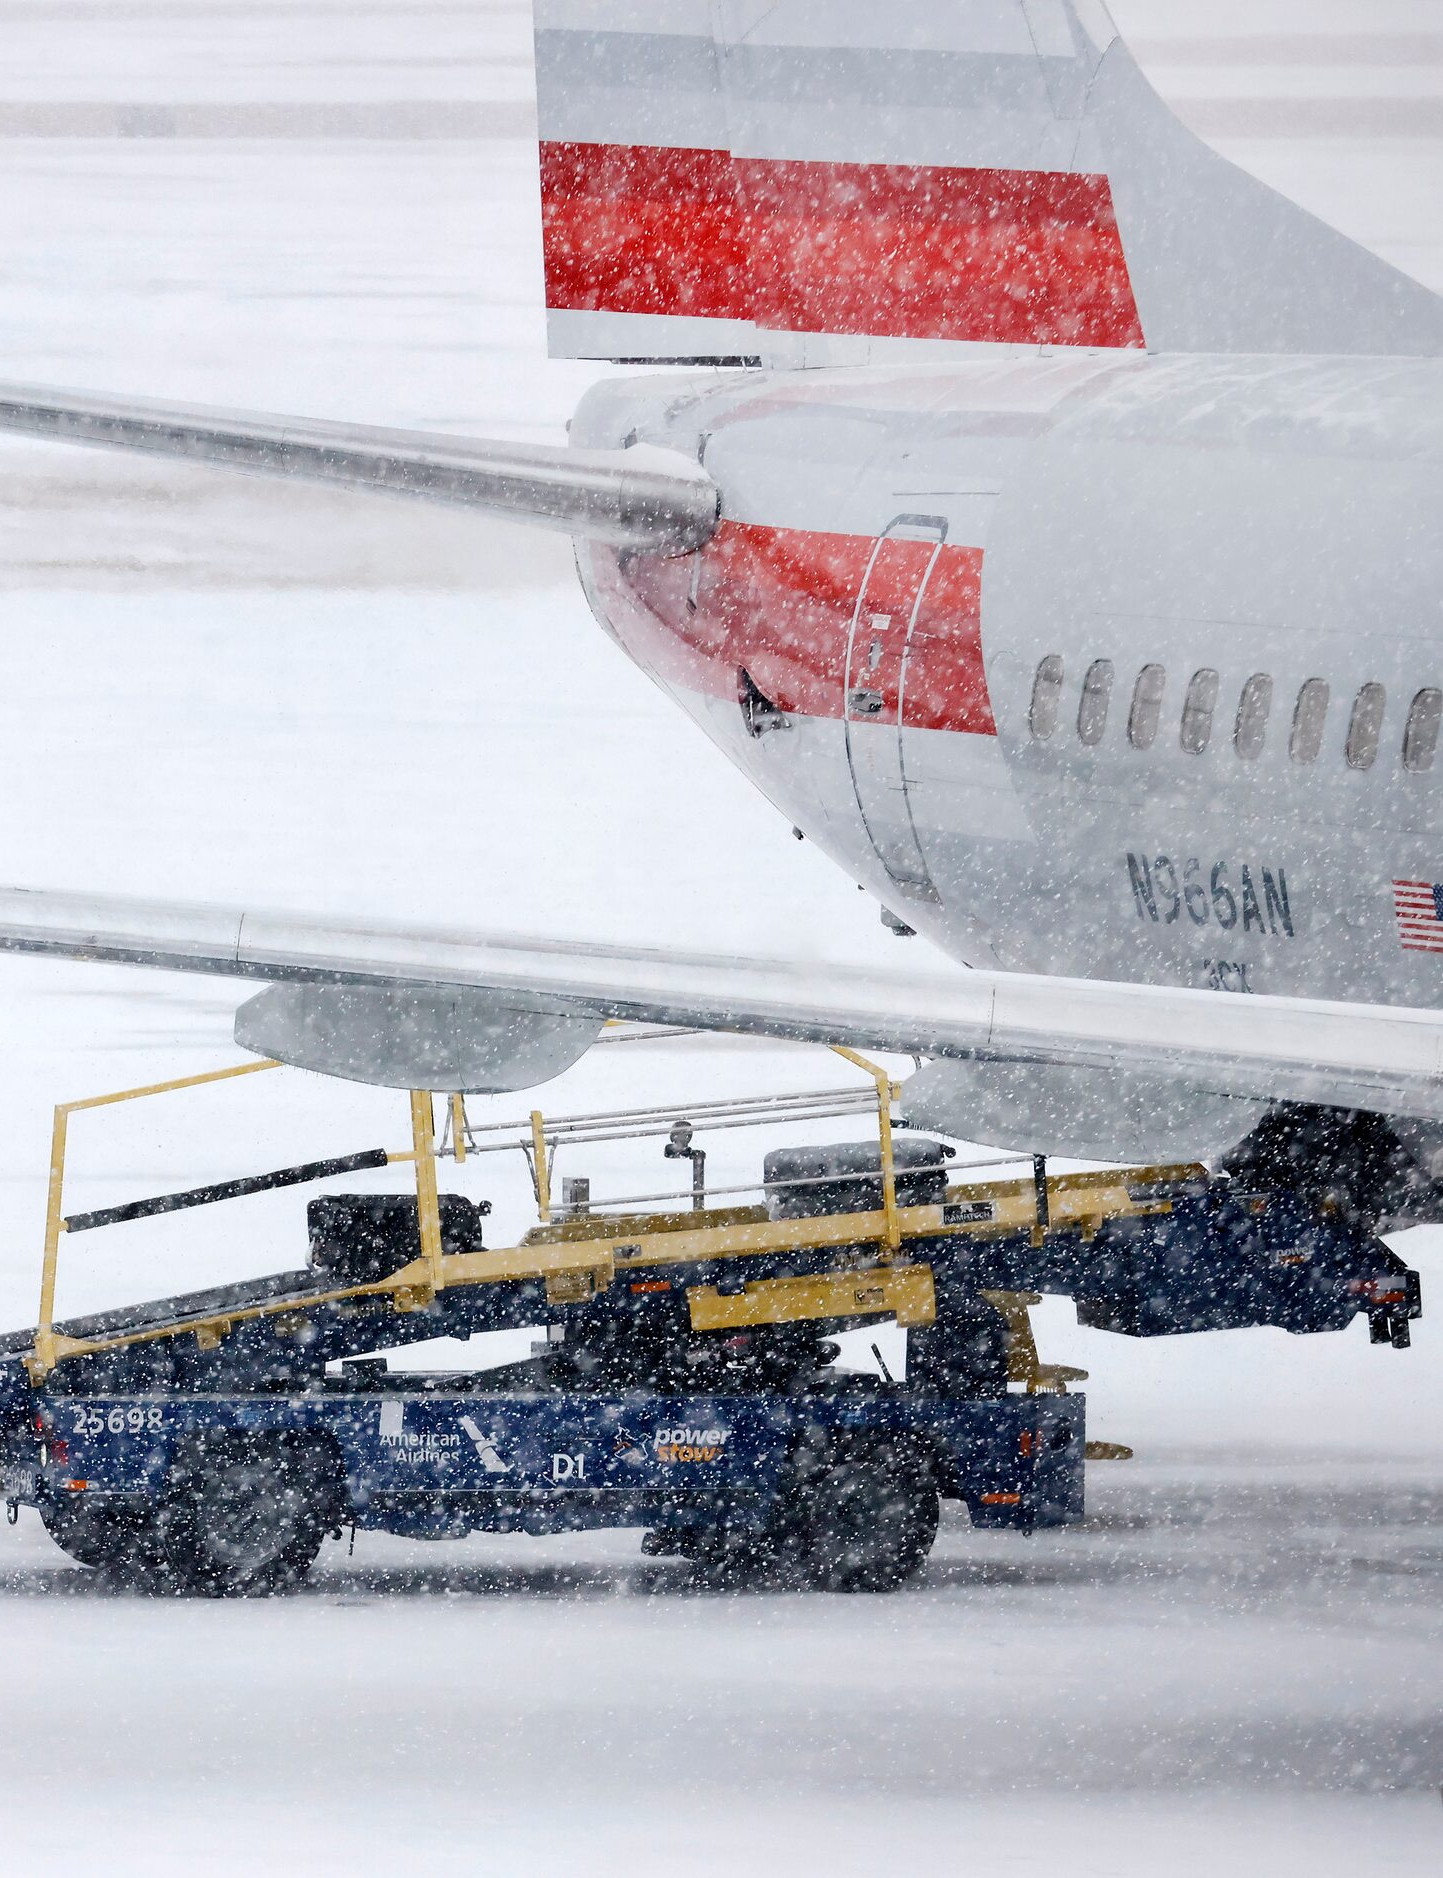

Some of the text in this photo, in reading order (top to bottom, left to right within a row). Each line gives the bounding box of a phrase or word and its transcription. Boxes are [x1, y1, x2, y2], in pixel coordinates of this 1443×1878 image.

[1127, 853, 1294, 937] N966AN
[72, 1406, 163, 1434] 25698
[379, 1432, 460, 1447] American
[653, 1429, 732, 1449] power
[396, 1446, 460, 1462] Airlines
[656, 1443, 718, 1463] stow
[553, 1454, 585, 1481] D1
